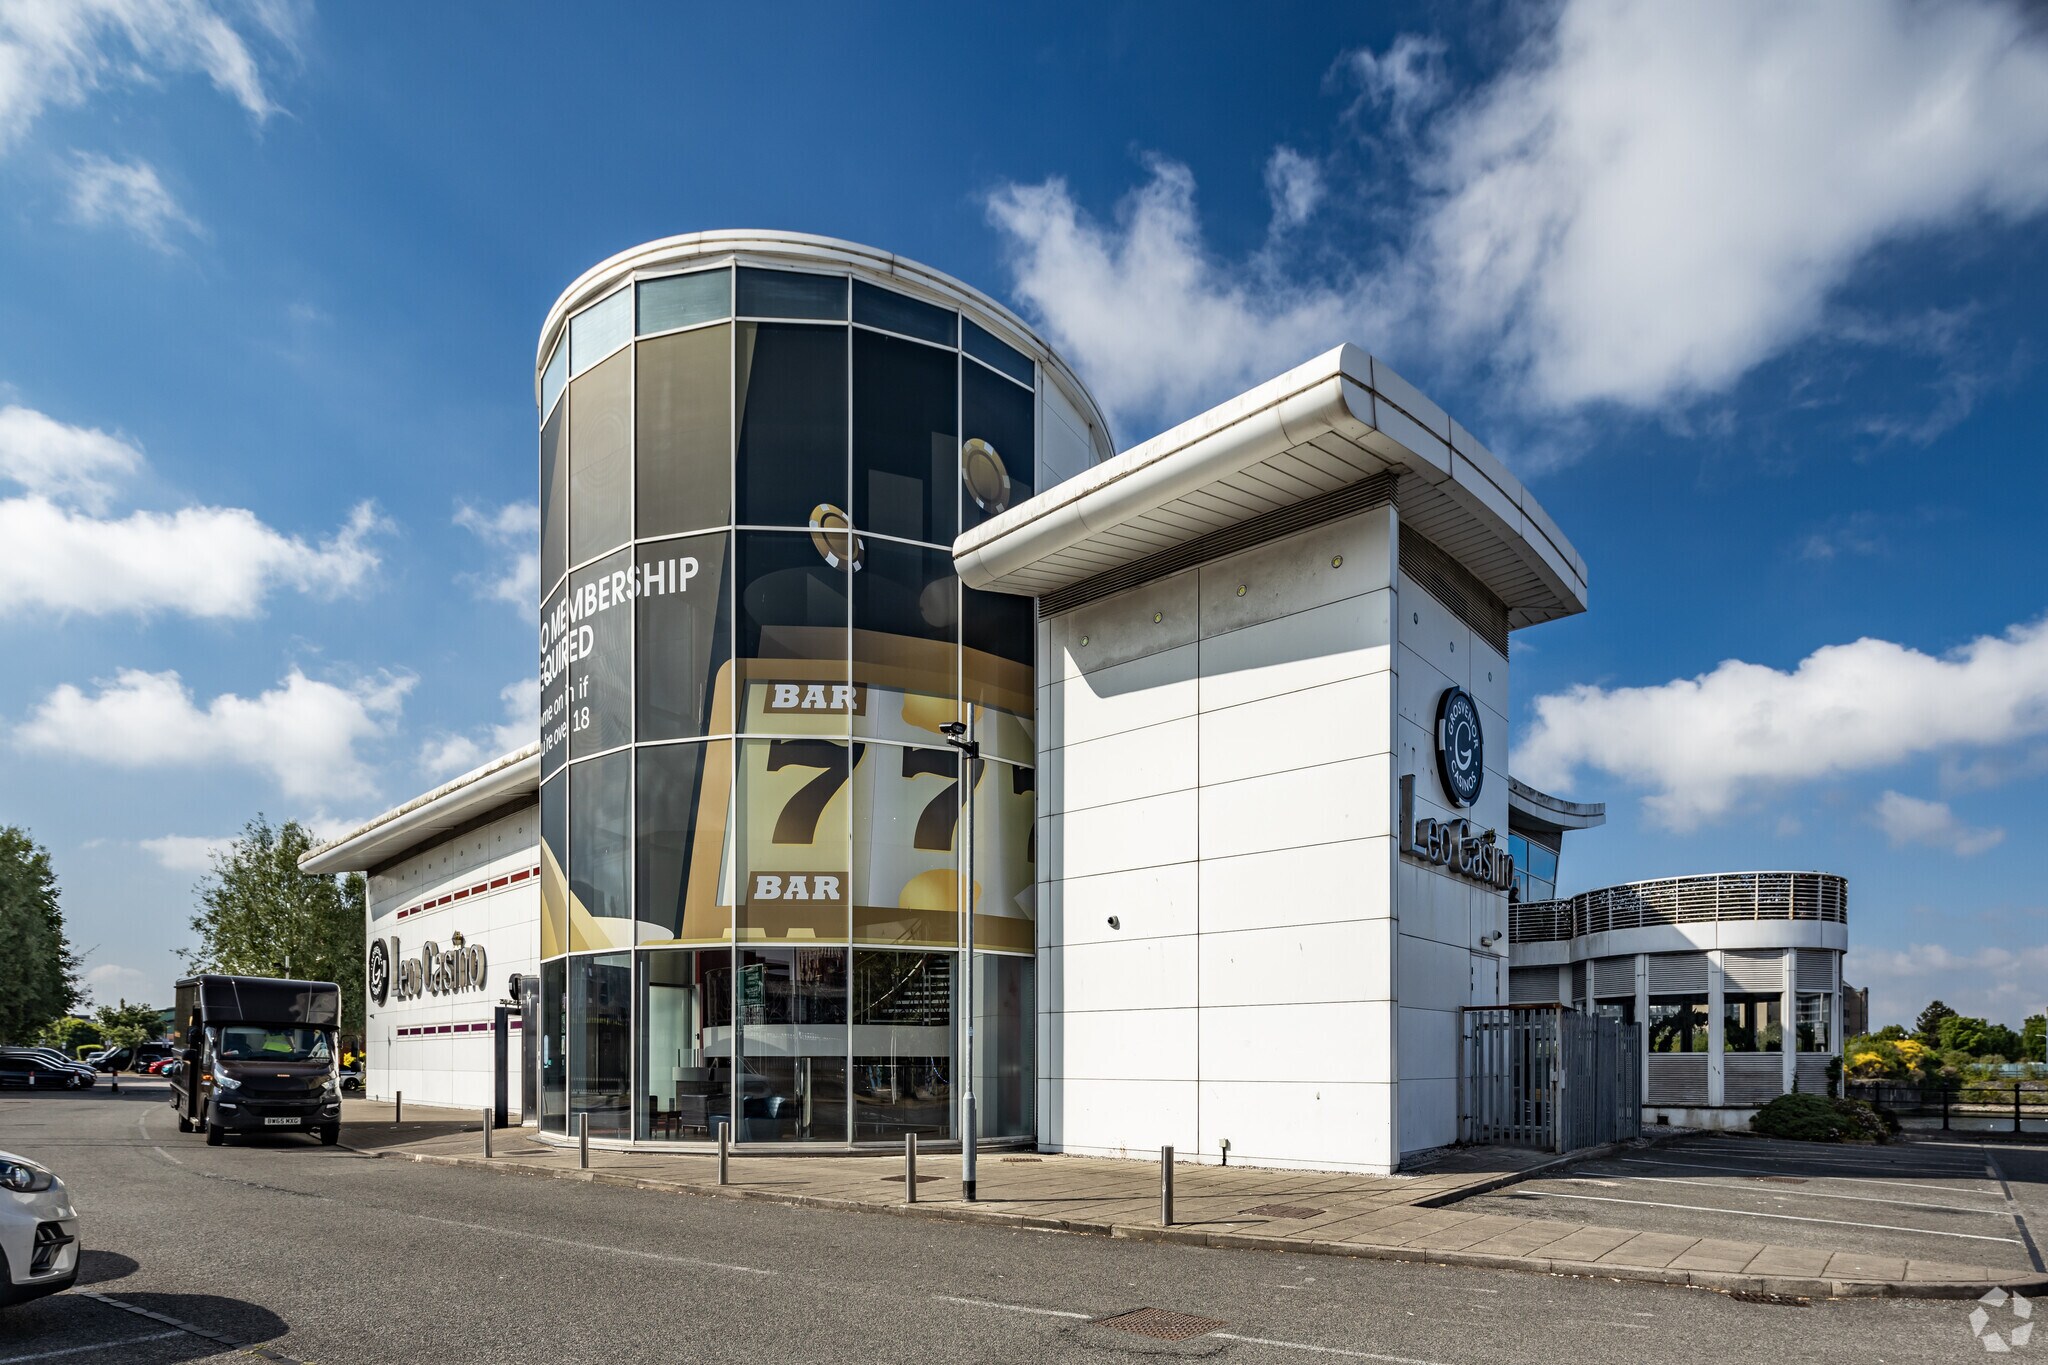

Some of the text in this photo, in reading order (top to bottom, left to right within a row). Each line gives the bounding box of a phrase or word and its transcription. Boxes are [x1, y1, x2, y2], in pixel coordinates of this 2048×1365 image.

[551, 557, 699, 644] MEMBERSHIP
[554, 694, 563, 715] on
[579, 674, 589, 699] if
[772, 684, 857, 710] BAR
[554, 722, 567, 745] ove
[573, 706, 590, 732] 18
[1448, 701, 1478, 749] GROSVENOR
[1455, 721, 1473, 771] G
[767, 739, 866, 844] 7
[902, 746, 985, 851] 7
[1451, 759, 1477, 791] CASINOS
[1401, 774, 1514, 891] Leo Casino
[753, 875, 840, 901] BAR
[390, 936, 422, 998] Leo
[422, 941, 486, 992] Casino
